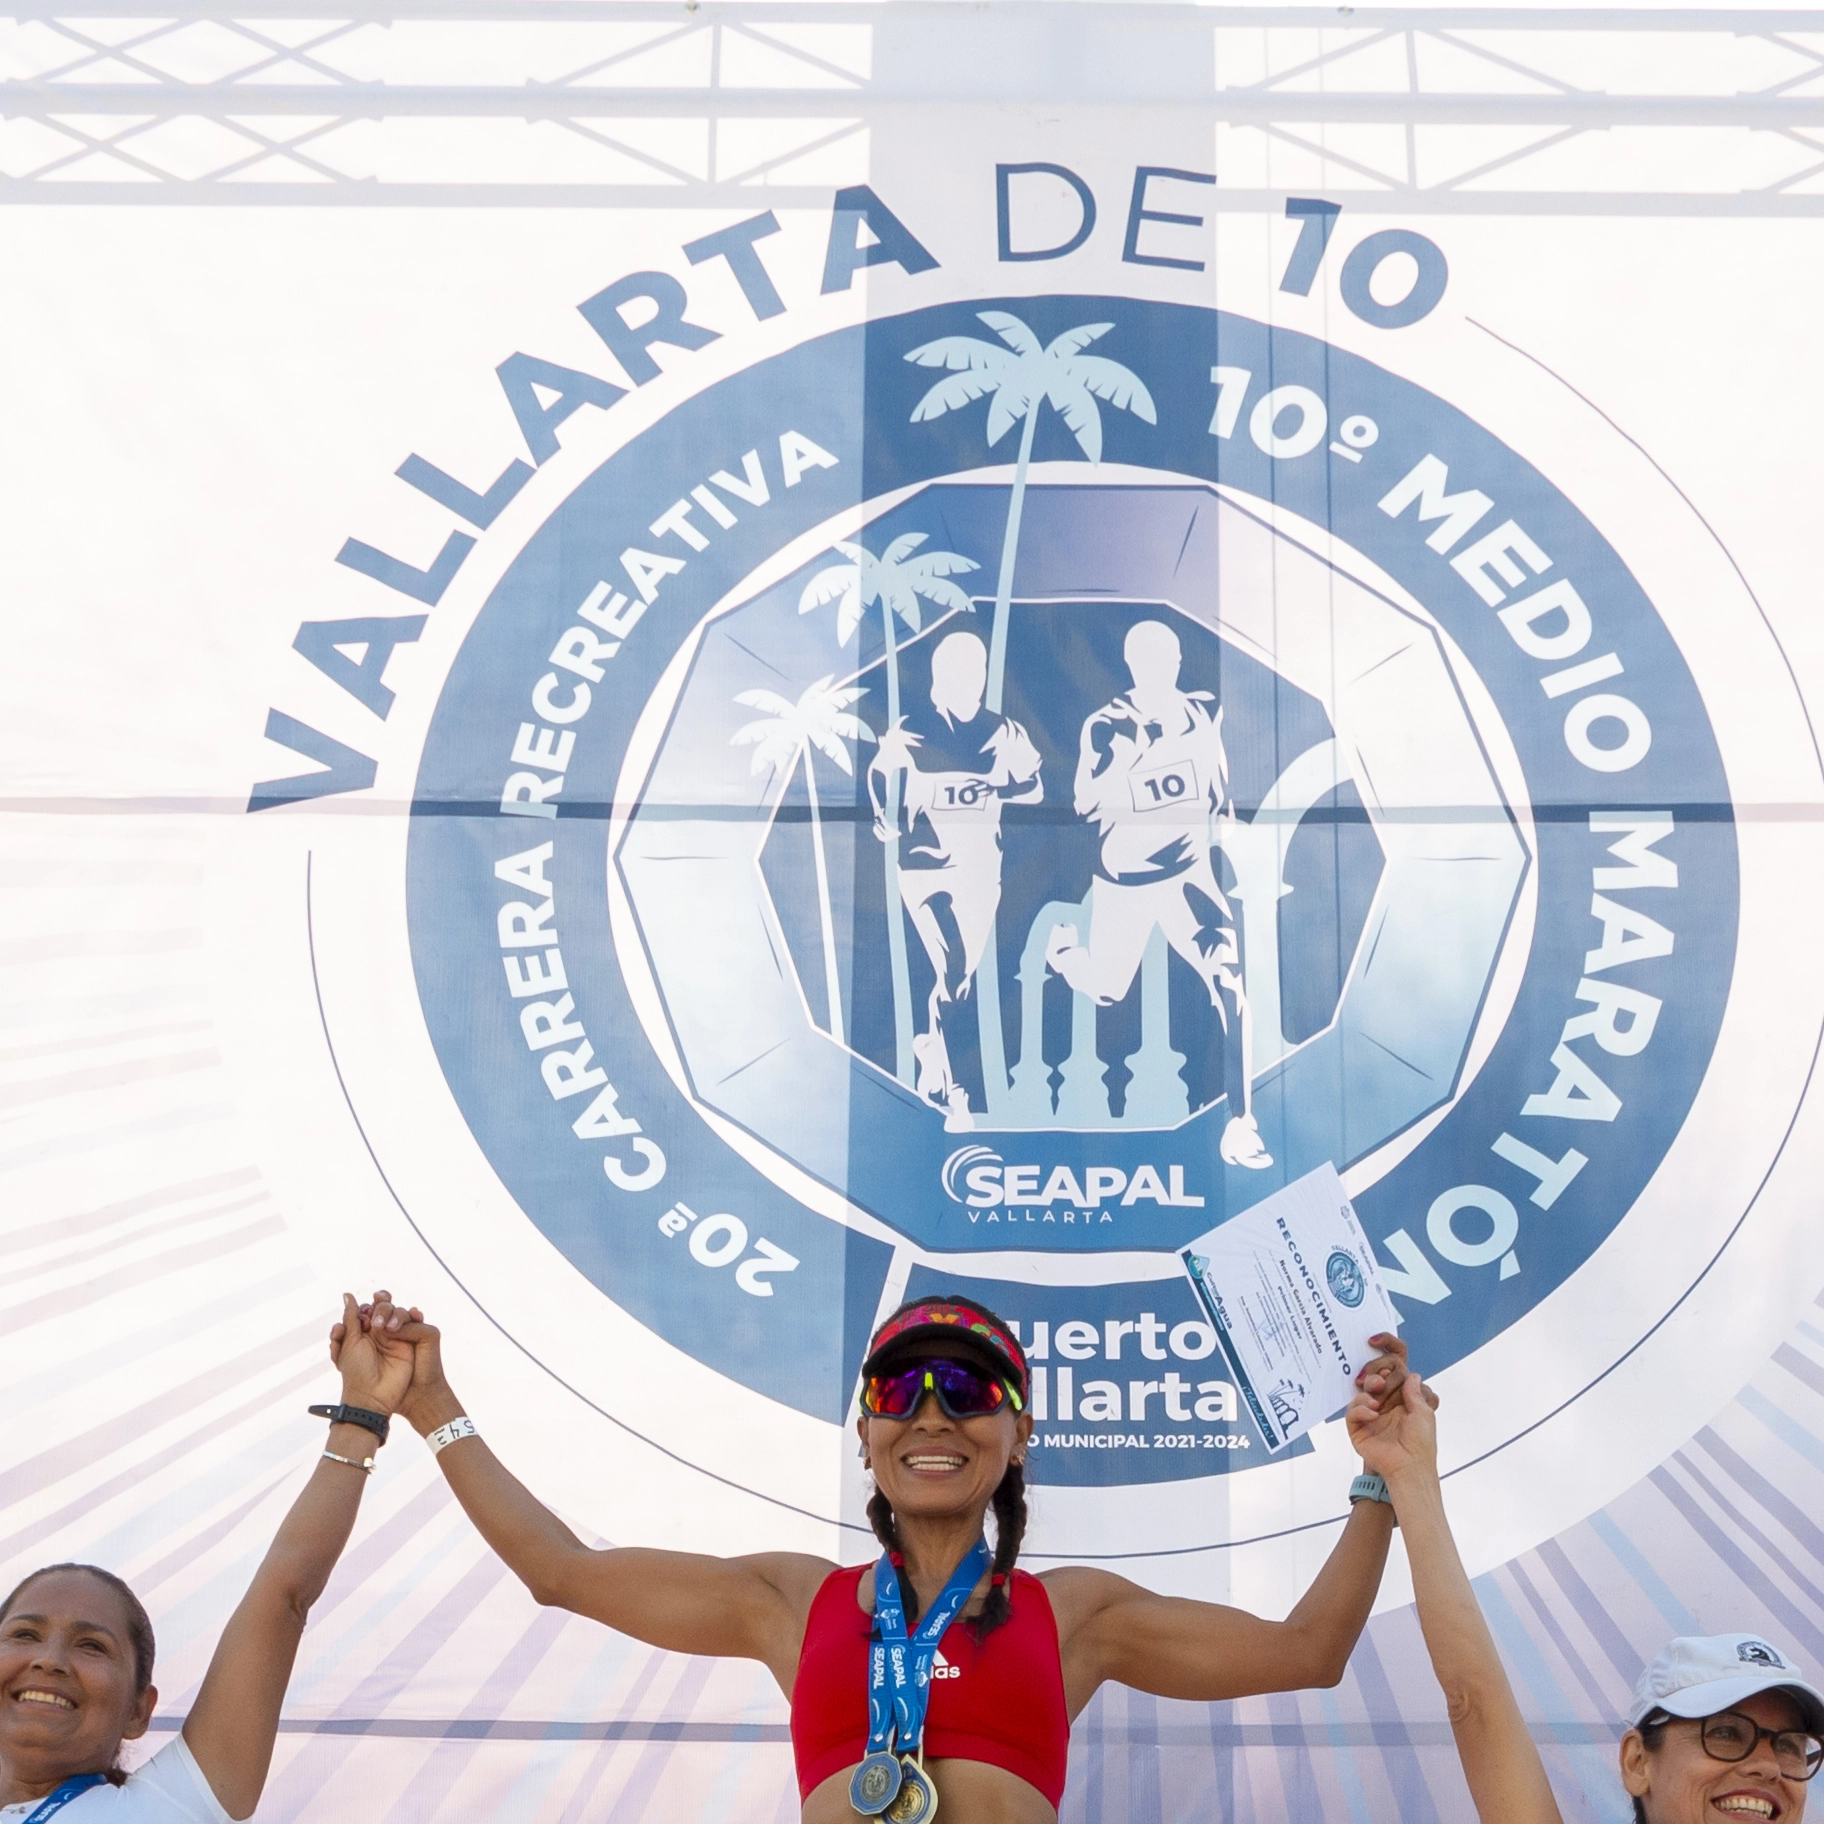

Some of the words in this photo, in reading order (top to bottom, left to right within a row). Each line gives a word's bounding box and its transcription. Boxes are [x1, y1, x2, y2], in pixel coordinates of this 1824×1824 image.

[245, 182, 943, 815] VALLARTA
[993, 161, 1218, 273] DE
[1276, 197, 1451, 331] 10
[499, 427, 840, 821] RECREATIVA
[1374, 452, 1656, 776] MEDIO
[943, 785, 978, 806] 10
[1144, 773, 1186, 802] 10
[494, 840, 668, 1192] CARRERA
[965, 1165, 1206, 1209] SEAPAL
[968, 1209, 1114, 1224] VALLARTA
[1276, 1217, 1351, 1377] RECONOCIMIENTO
[1016, 1312, 1217, 1361] uerto
[1032, 1366, 1238, 1422] llarta
[1044, 1433, 1149, 1449] MUNICIPAL
[1153, 1434, 1251, 1450] 2021-2024
[873, 1647, 885, 1690] SEAPAL
[891, 1647, 907, 1689] SEAPAL
